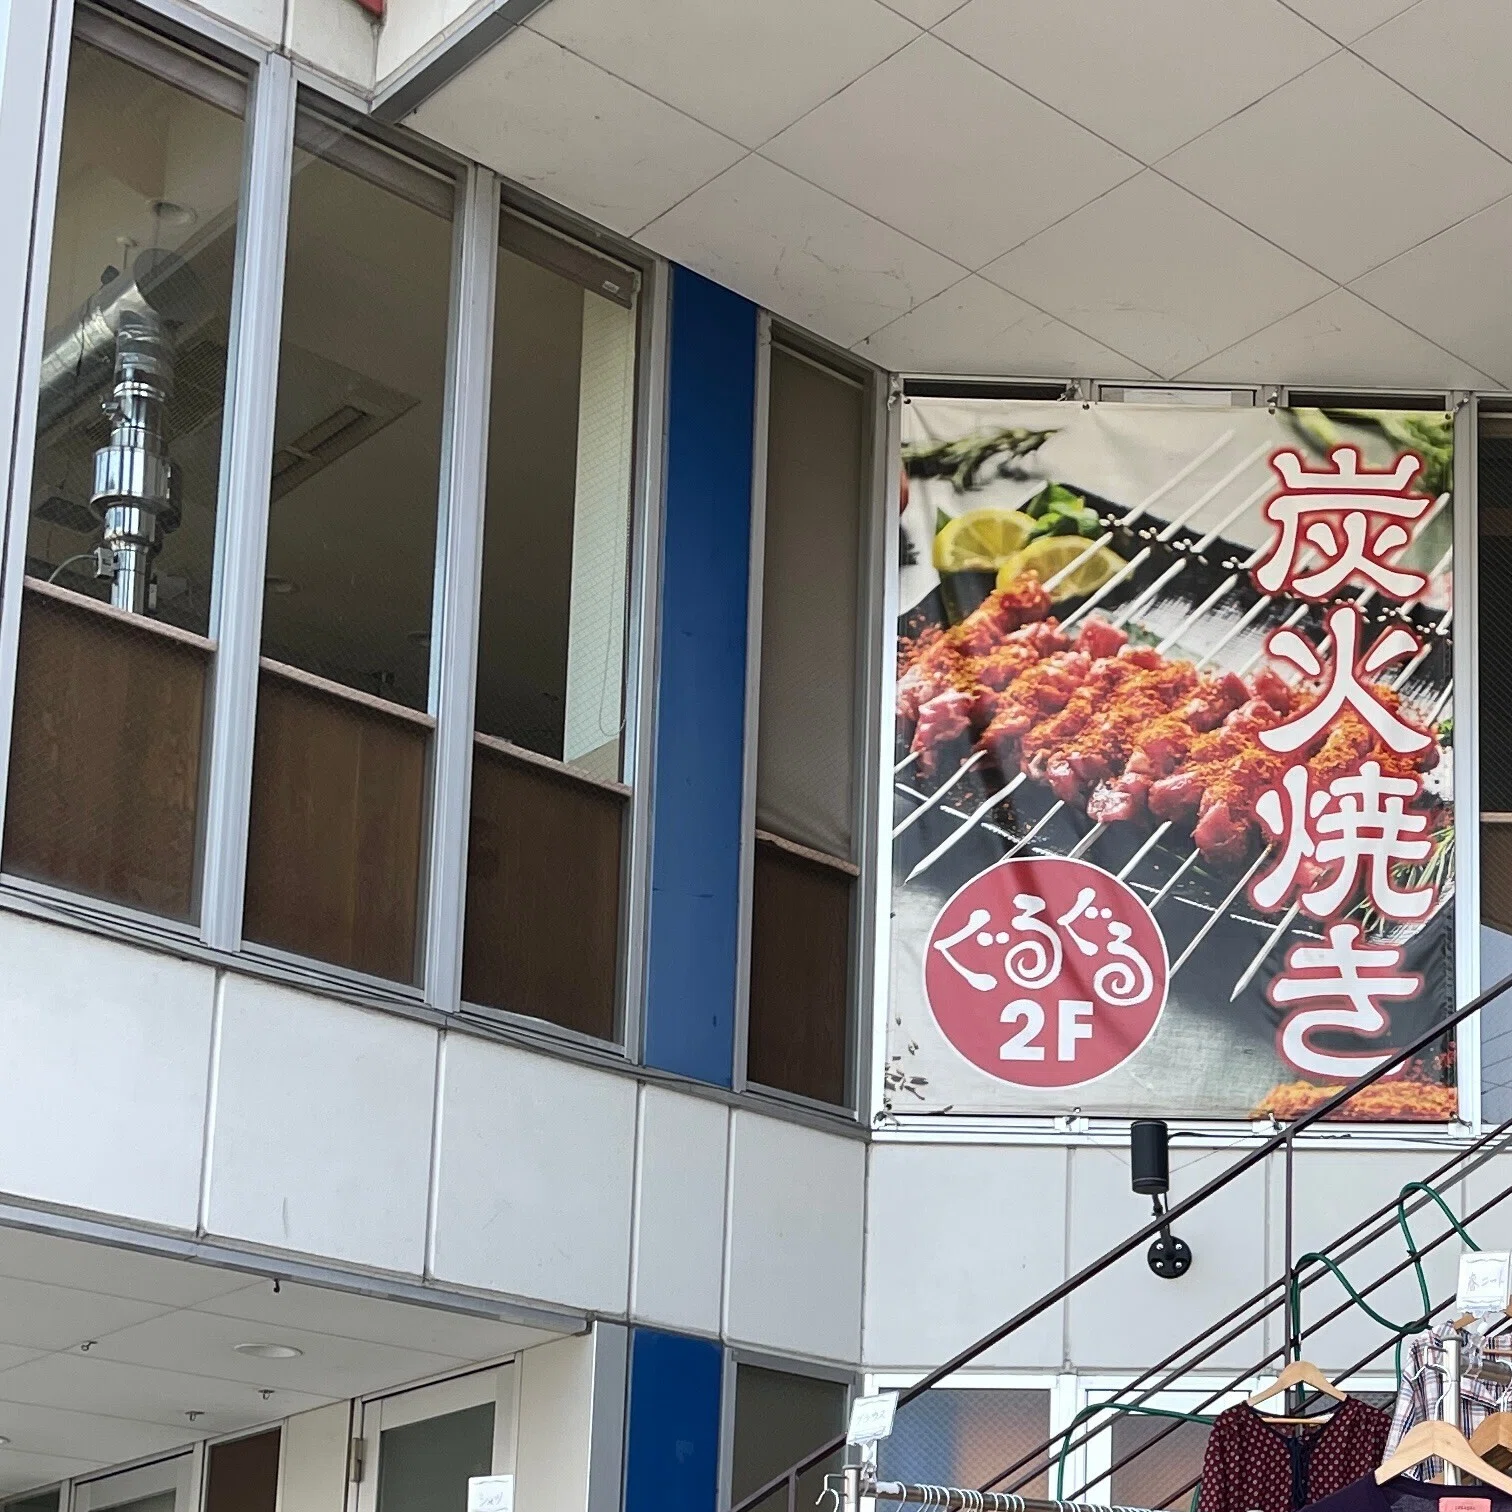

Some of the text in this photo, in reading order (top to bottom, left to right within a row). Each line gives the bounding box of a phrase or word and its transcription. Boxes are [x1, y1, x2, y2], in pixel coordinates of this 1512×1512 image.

[1251, 446, 1436, 1080] 炭火焼き
[933, 887, 1154, 1006] ぐるぐる
[999, 1000, 1094, 1062] 2F
